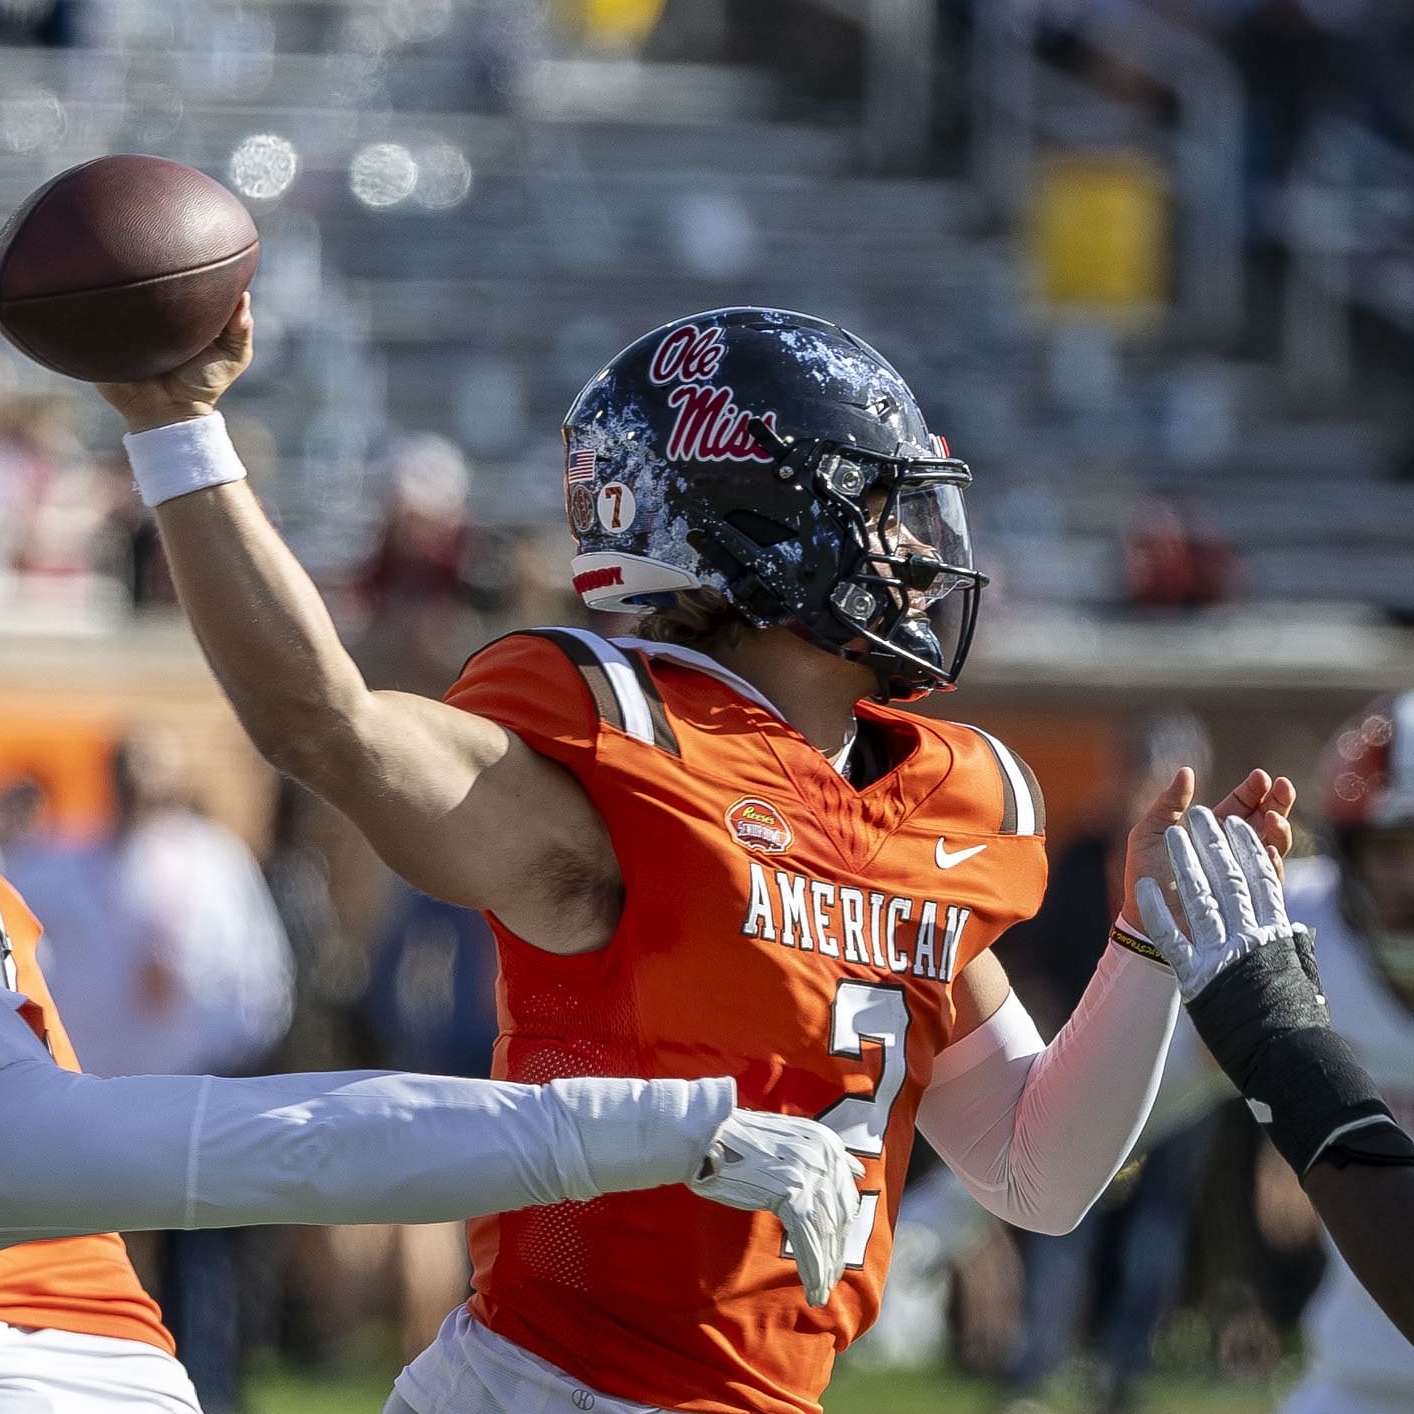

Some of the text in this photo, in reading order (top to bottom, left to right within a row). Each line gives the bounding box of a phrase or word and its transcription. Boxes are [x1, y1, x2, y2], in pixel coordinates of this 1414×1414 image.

[650, 325, 725, 383] Ole
[605, 486, 623, 529] 7
[742, 862, 971, 983] AMERICAN
